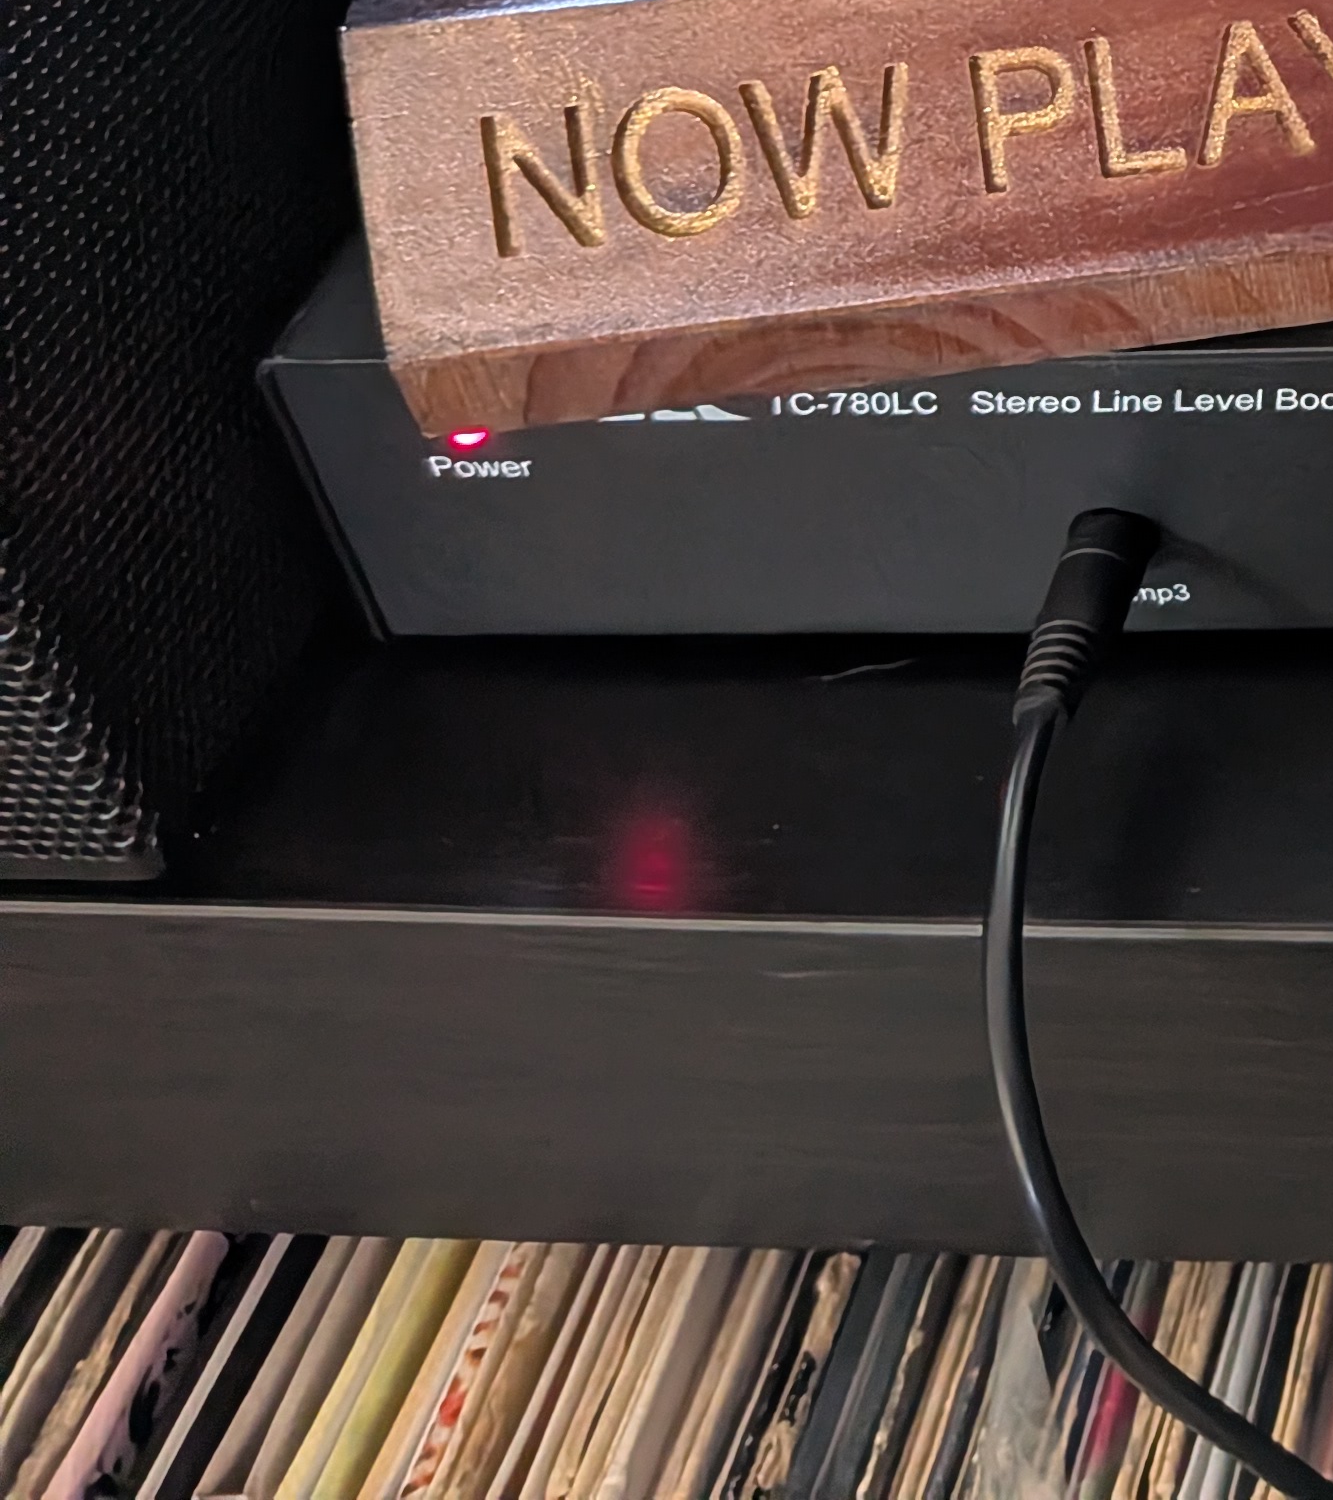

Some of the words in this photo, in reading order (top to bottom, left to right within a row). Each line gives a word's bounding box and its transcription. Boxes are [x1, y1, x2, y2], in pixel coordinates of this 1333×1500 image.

[480, 61, 909, 257] NOW
[970, 389, 1082, 414] Stereo
[1091, 389, 1164, 413] Line
[1173, 388, 1264, 413] Level
[427, 455, 532, 479] Power
[1132, 583, 1191, 606] mp3
